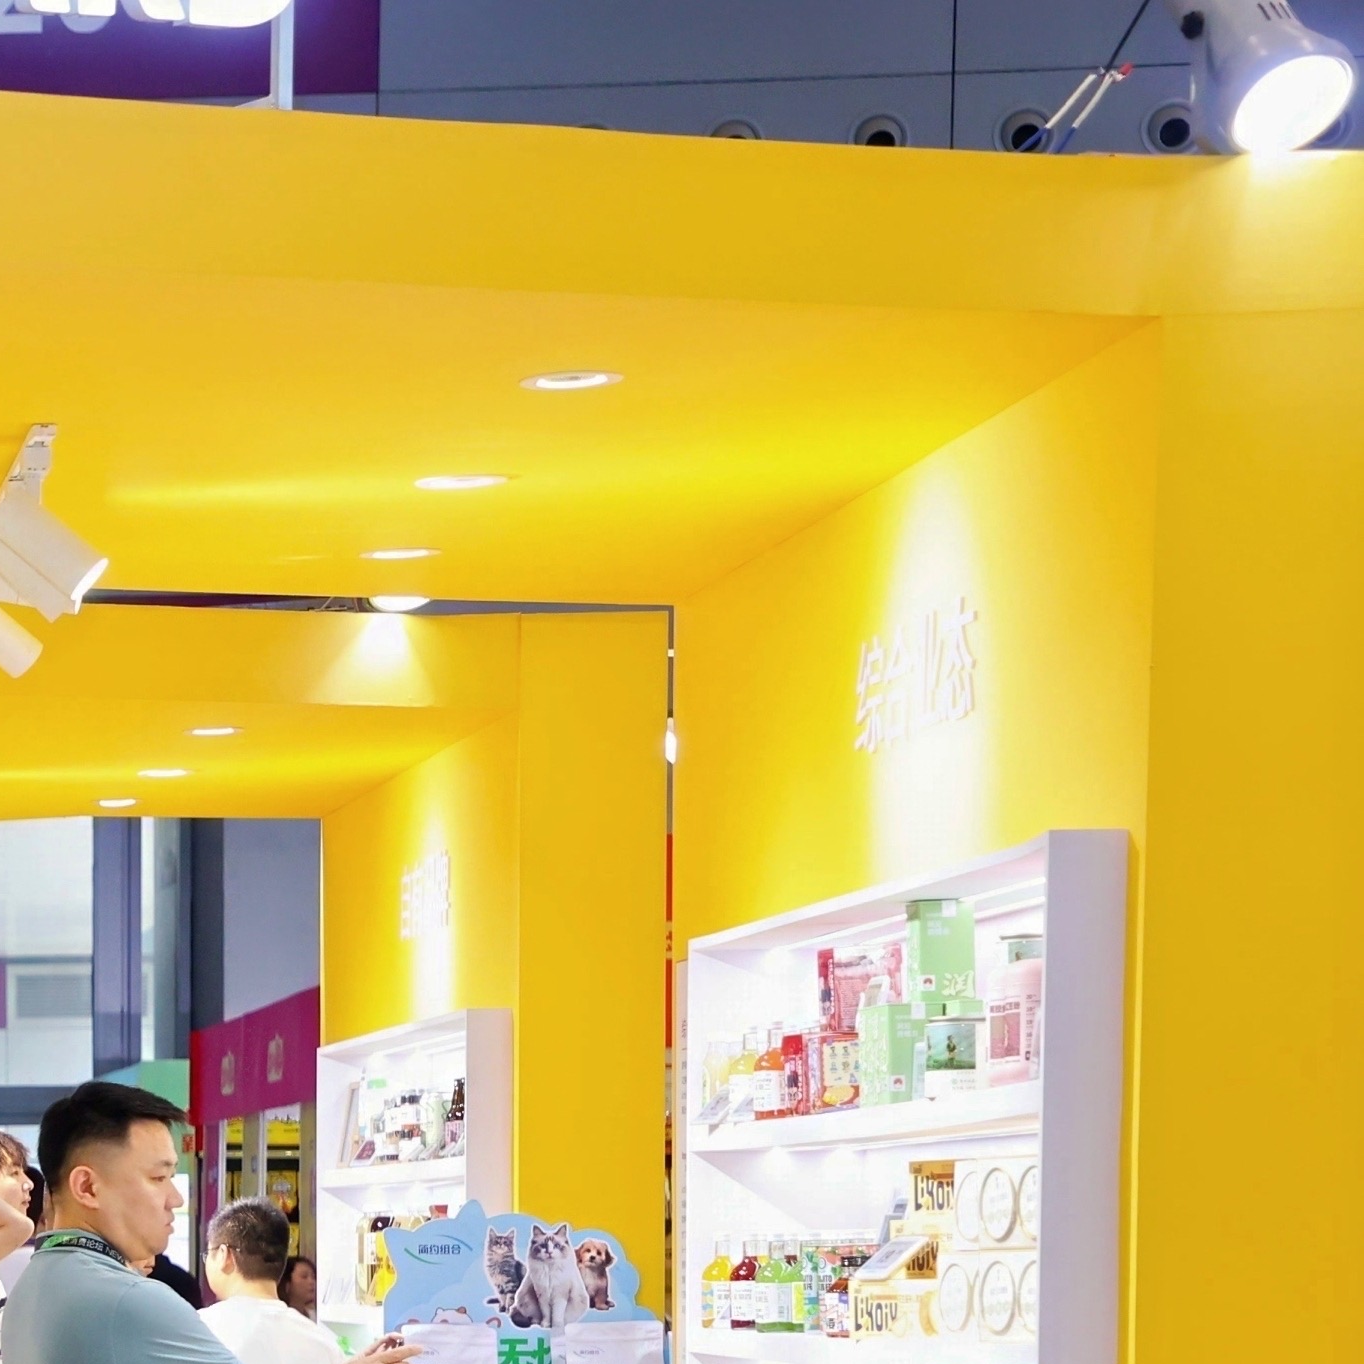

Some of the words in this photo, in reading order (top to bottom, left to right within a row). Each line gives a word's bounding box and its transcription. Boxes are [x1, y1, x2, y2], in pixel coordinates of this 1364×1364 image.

[942, 970, 975, 998] 润
[418, 1243, 461, 1256] 简约组合
